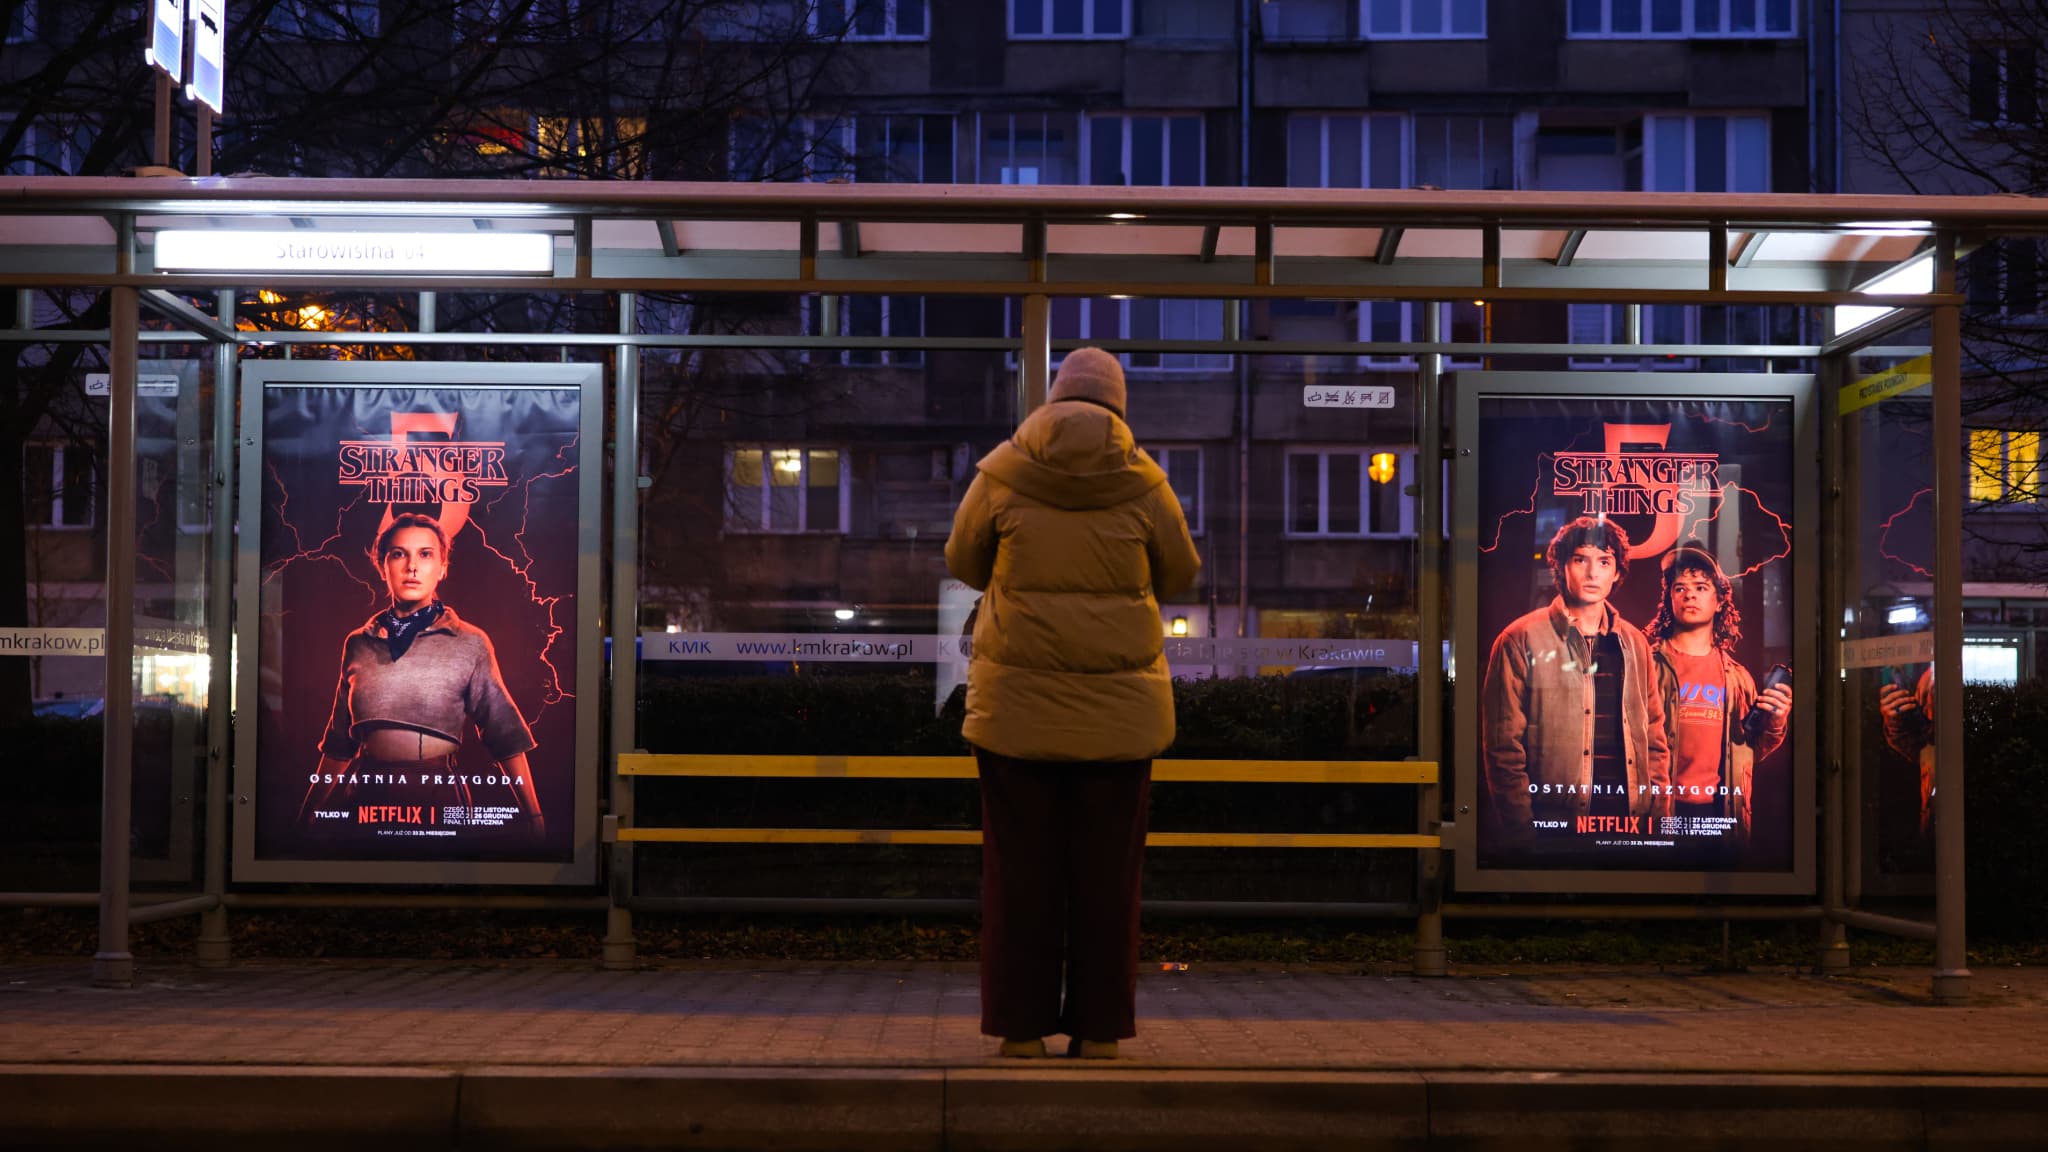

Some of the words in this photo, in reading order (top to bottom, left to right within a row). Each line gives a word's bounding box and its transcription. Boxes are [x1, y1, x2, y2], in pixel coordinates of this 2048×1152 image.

[339, 444, 508, 481] STRANGER
[1553, 455, 1722, 492] STRANGER
[366, 476, 482, 504] THINGS
[1581, 487, 1697, 515] THINGS
[668, 640, 712, 655] KMK
[736, 638, 914, 660] www.kmkrakow.pl
[1299, 643, 1386, 661] Krakowie
[309, 773, 408, 785] OSTATNIA
[421, 774, 525, 786] PRZYGODA
[1528, 783, 1626, 795] OSTATNIA
[1639, 784, 1743, 796] PRZYGODA
[314, 810, 341, 819] TYLKO
[341, 810, 350, 819] W
[358, 805, 422, 825] NETFLIX
[1533, 820, 1560, 829] TYLKO
[1560, 820, 1568, 829] W
[1576, 815, 1640, 835] NETFLIX
